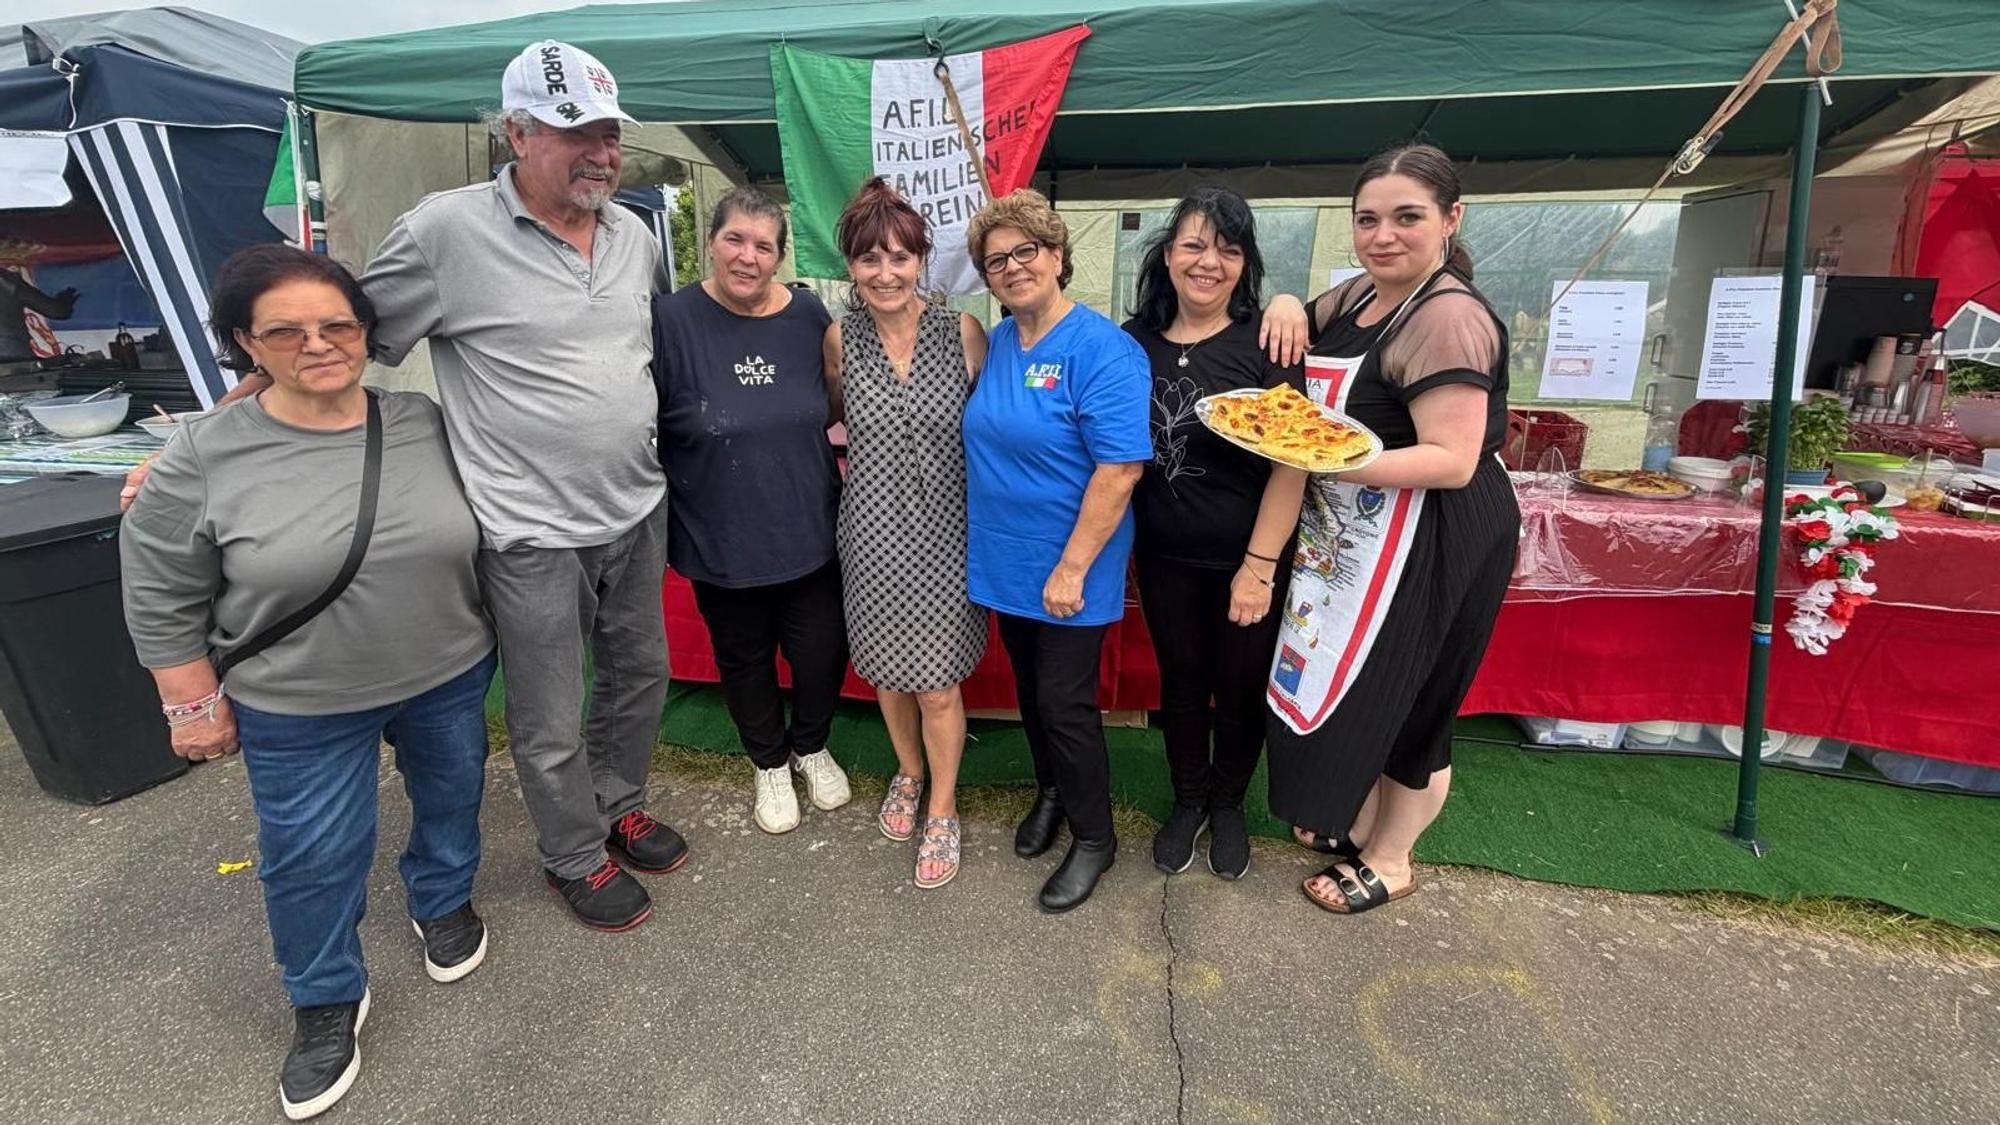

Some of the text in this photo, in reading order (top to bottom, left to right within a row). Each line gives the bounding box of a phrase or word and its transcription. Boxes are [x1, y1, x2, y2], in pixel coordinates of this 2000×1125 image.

[540, 46, 569, 96] SARDE
[877, 100, 1037, 162] ITALIENSCHE
[746, 355, 765, 366] LA
[734, 363, 776, 375] DOLCE
[738, 375, 774, 386] VITA
